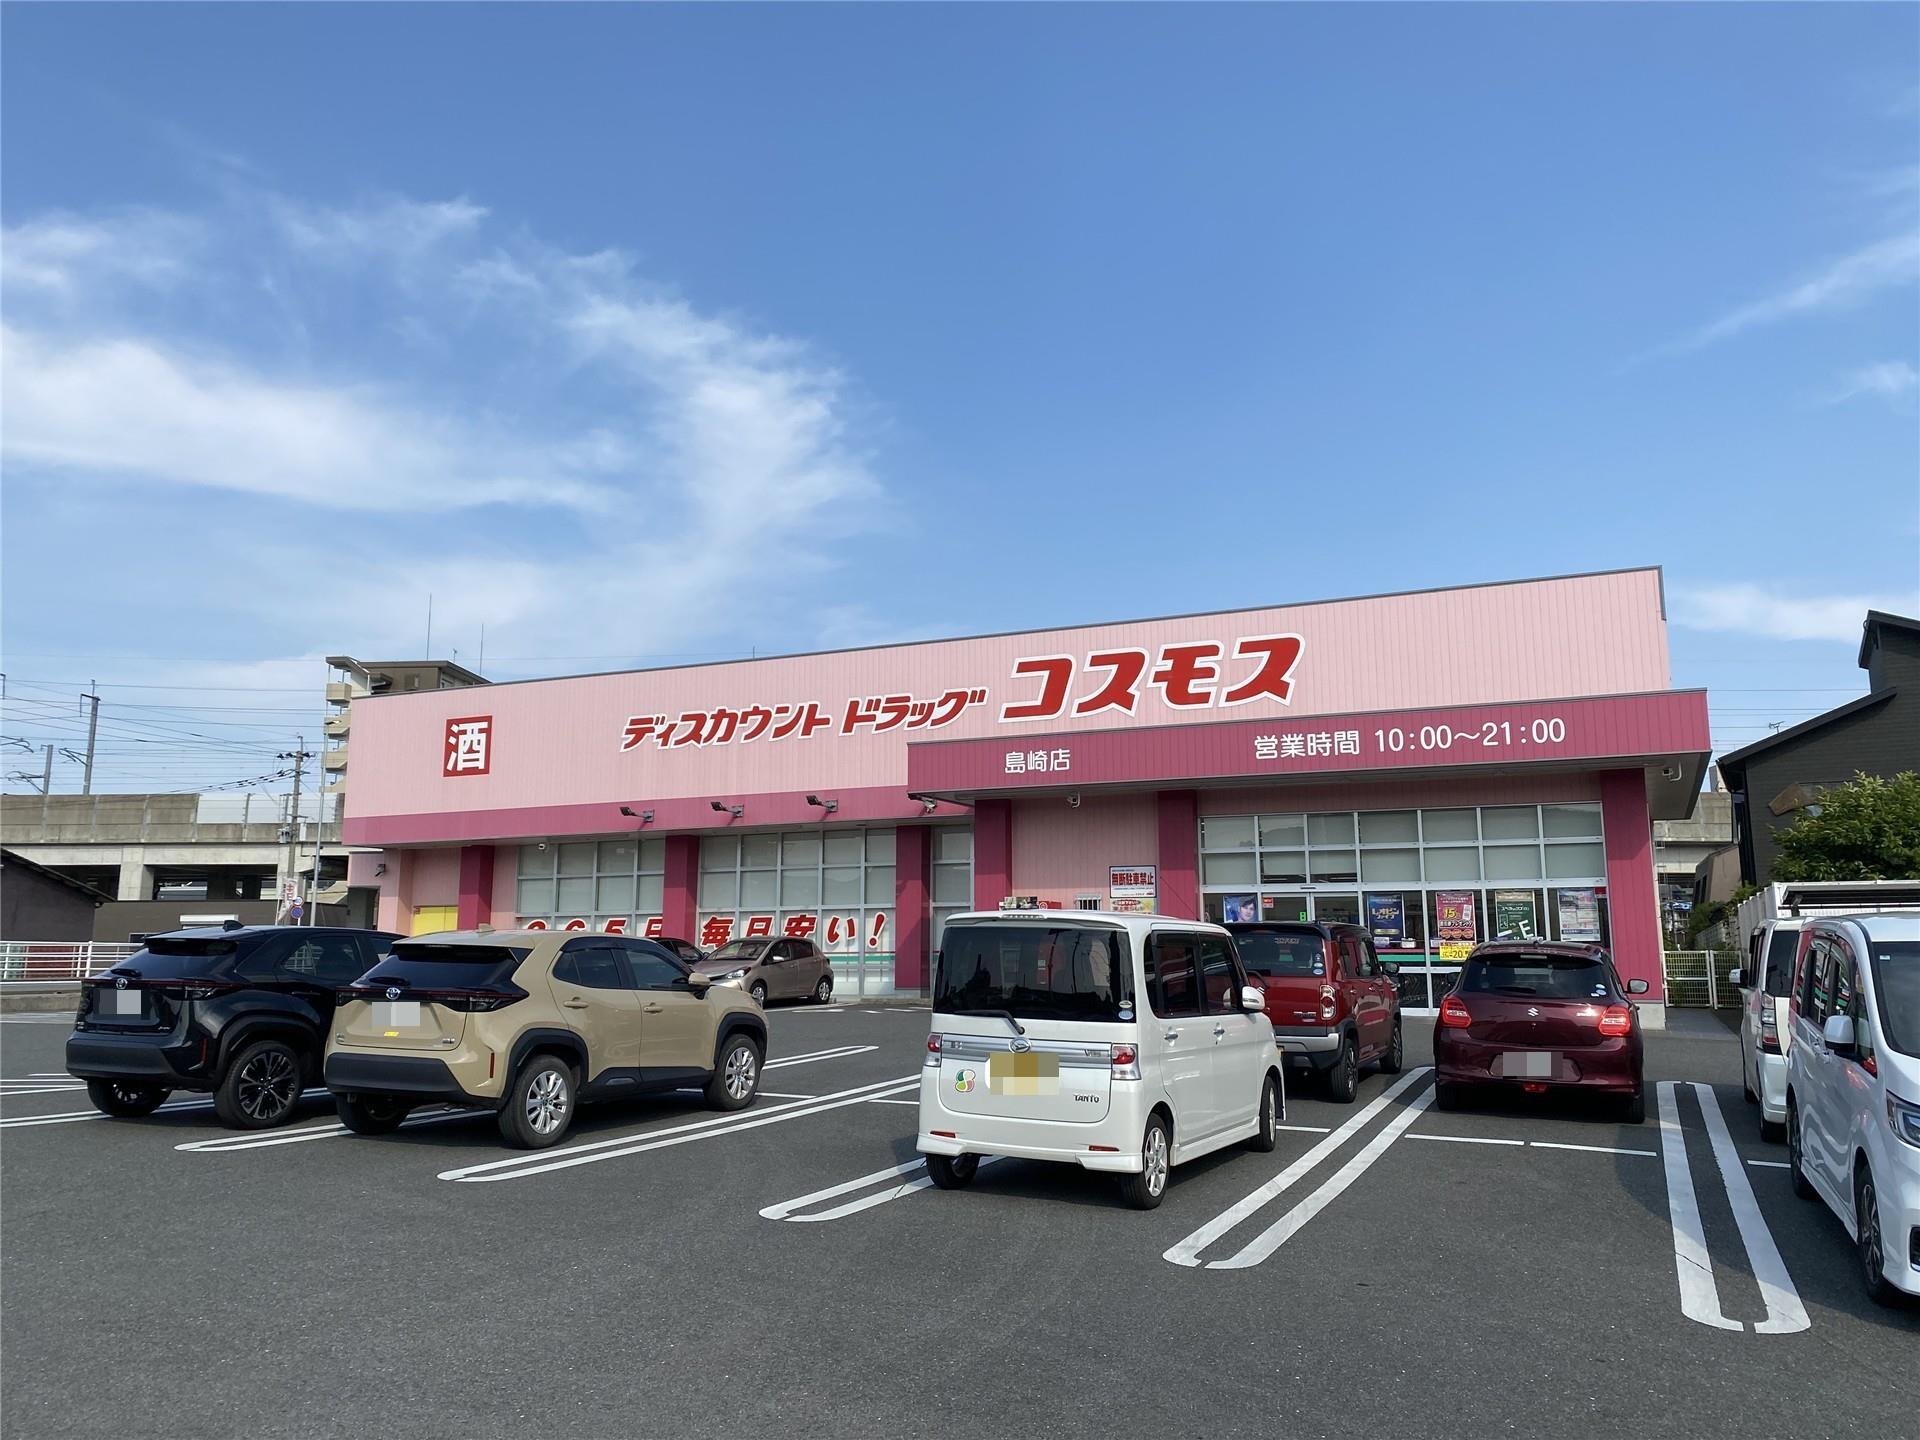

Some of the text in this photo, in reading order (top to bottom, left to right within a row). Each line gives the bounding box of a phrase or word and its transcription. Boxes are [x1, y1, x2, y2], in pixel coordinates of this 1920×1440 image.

[998, 633, 1307, 724] コスモス
[620, 687, 990, 753] ディスカウント ドラッグ
[446, 721, 489, 772] 酒
[1253, 729, 1360, 760] 営業時間
[1004, 747, 1072, 775] 島崎店
[1111, 871, 1154, 886] 無断駐車禁止
[1073, 1093, 1100, 1104] TANTO
